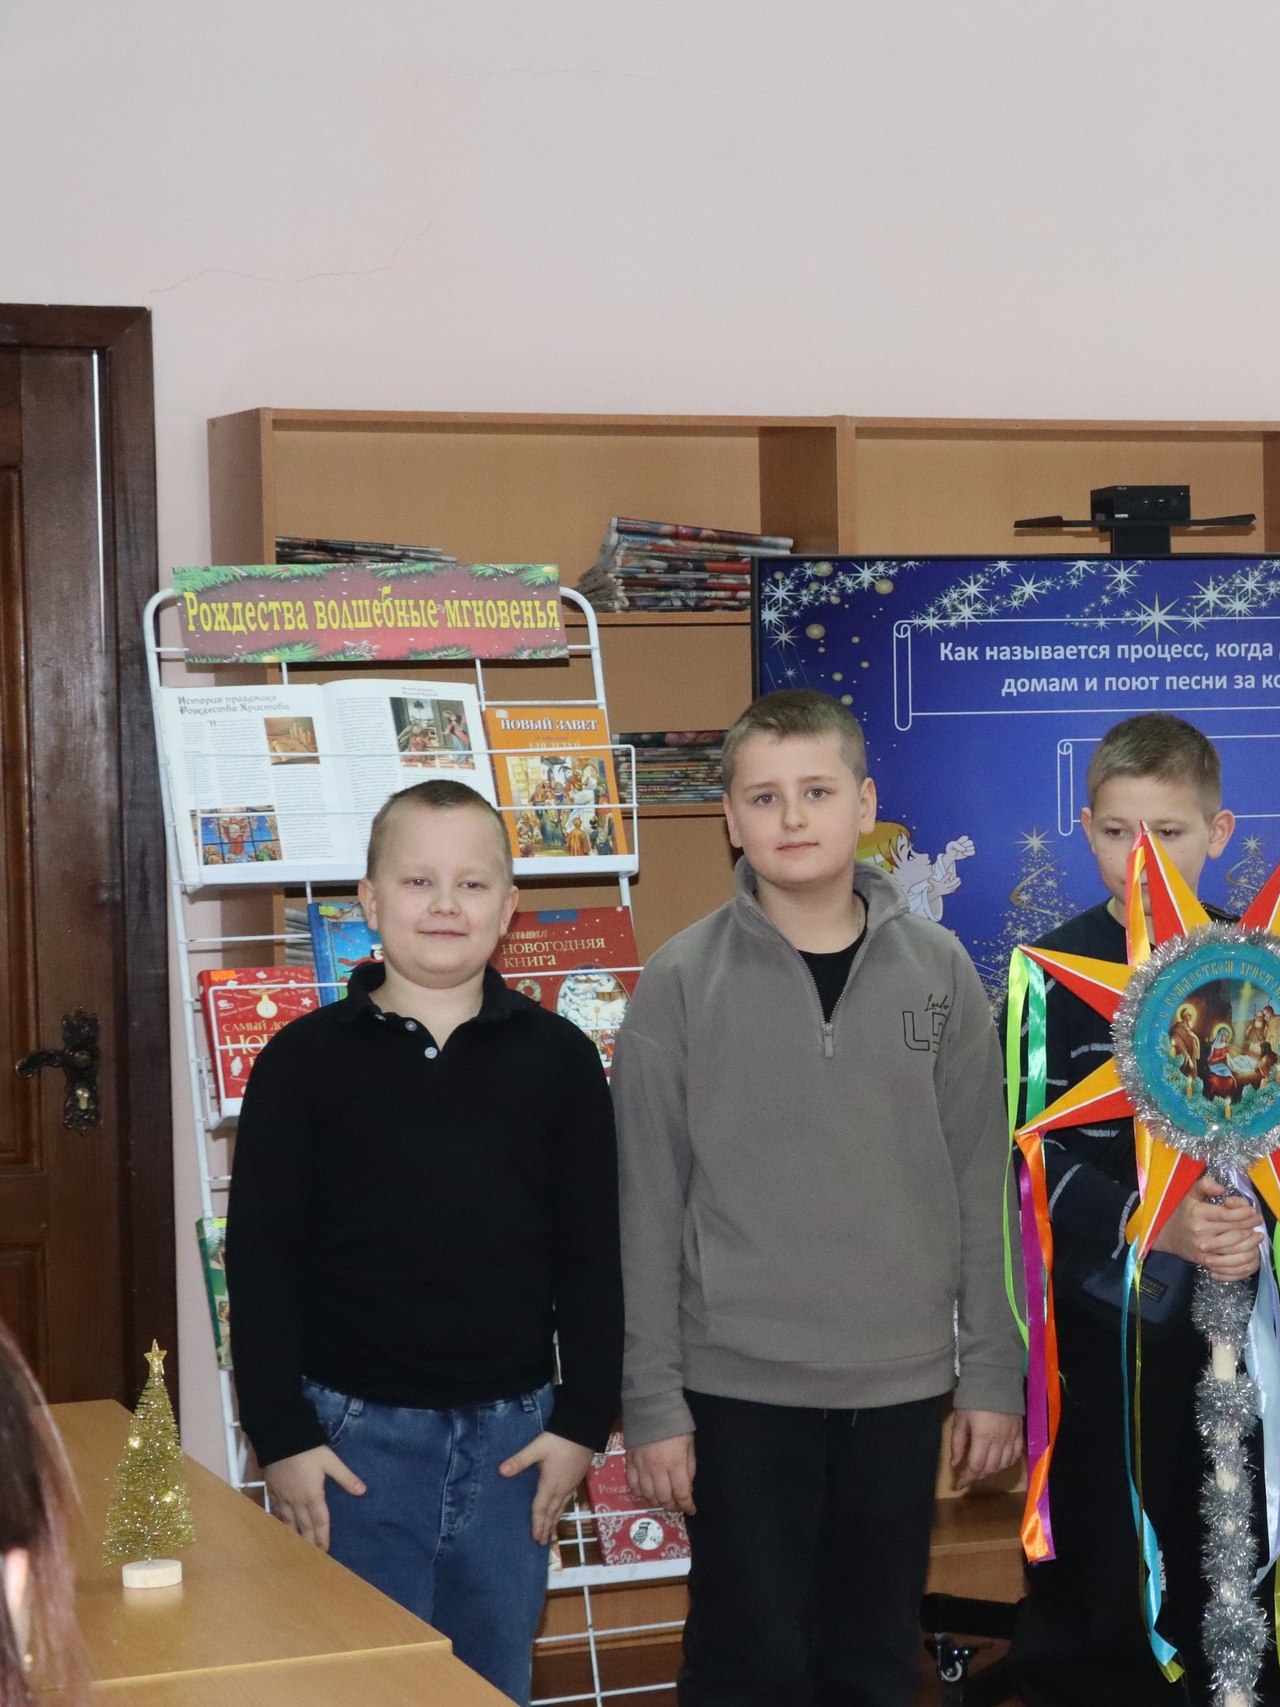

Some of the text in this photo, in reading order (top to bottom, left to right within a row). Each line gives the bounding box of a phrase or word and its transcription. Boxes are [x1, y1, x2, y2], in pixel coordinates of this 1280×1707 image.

[184, 584, 561, 635] Рождества волшебные мгновенья
[940, 642, 979, 661] Как
[985, 643, 1110, 661] называется
[1117, 643, 1209, 663] процесс,
[1215, 641, 1273, 661] когда
[1001, 676, 1078, 697] домам
[1085, 677, 1098, 692] и
[1104, 676, 1160, 692] поют
[1165, 674, 1228, 691] песни
[1233, 674, 1256, 689] за
[177, 696, 223, 706] История
[179, 703, 290, 716] Рождества Христова
[501, 718, 598, 731] НОВЫЙ ЗАВЕТ
[222, 1020, 268, 1033] САМЫЙ
